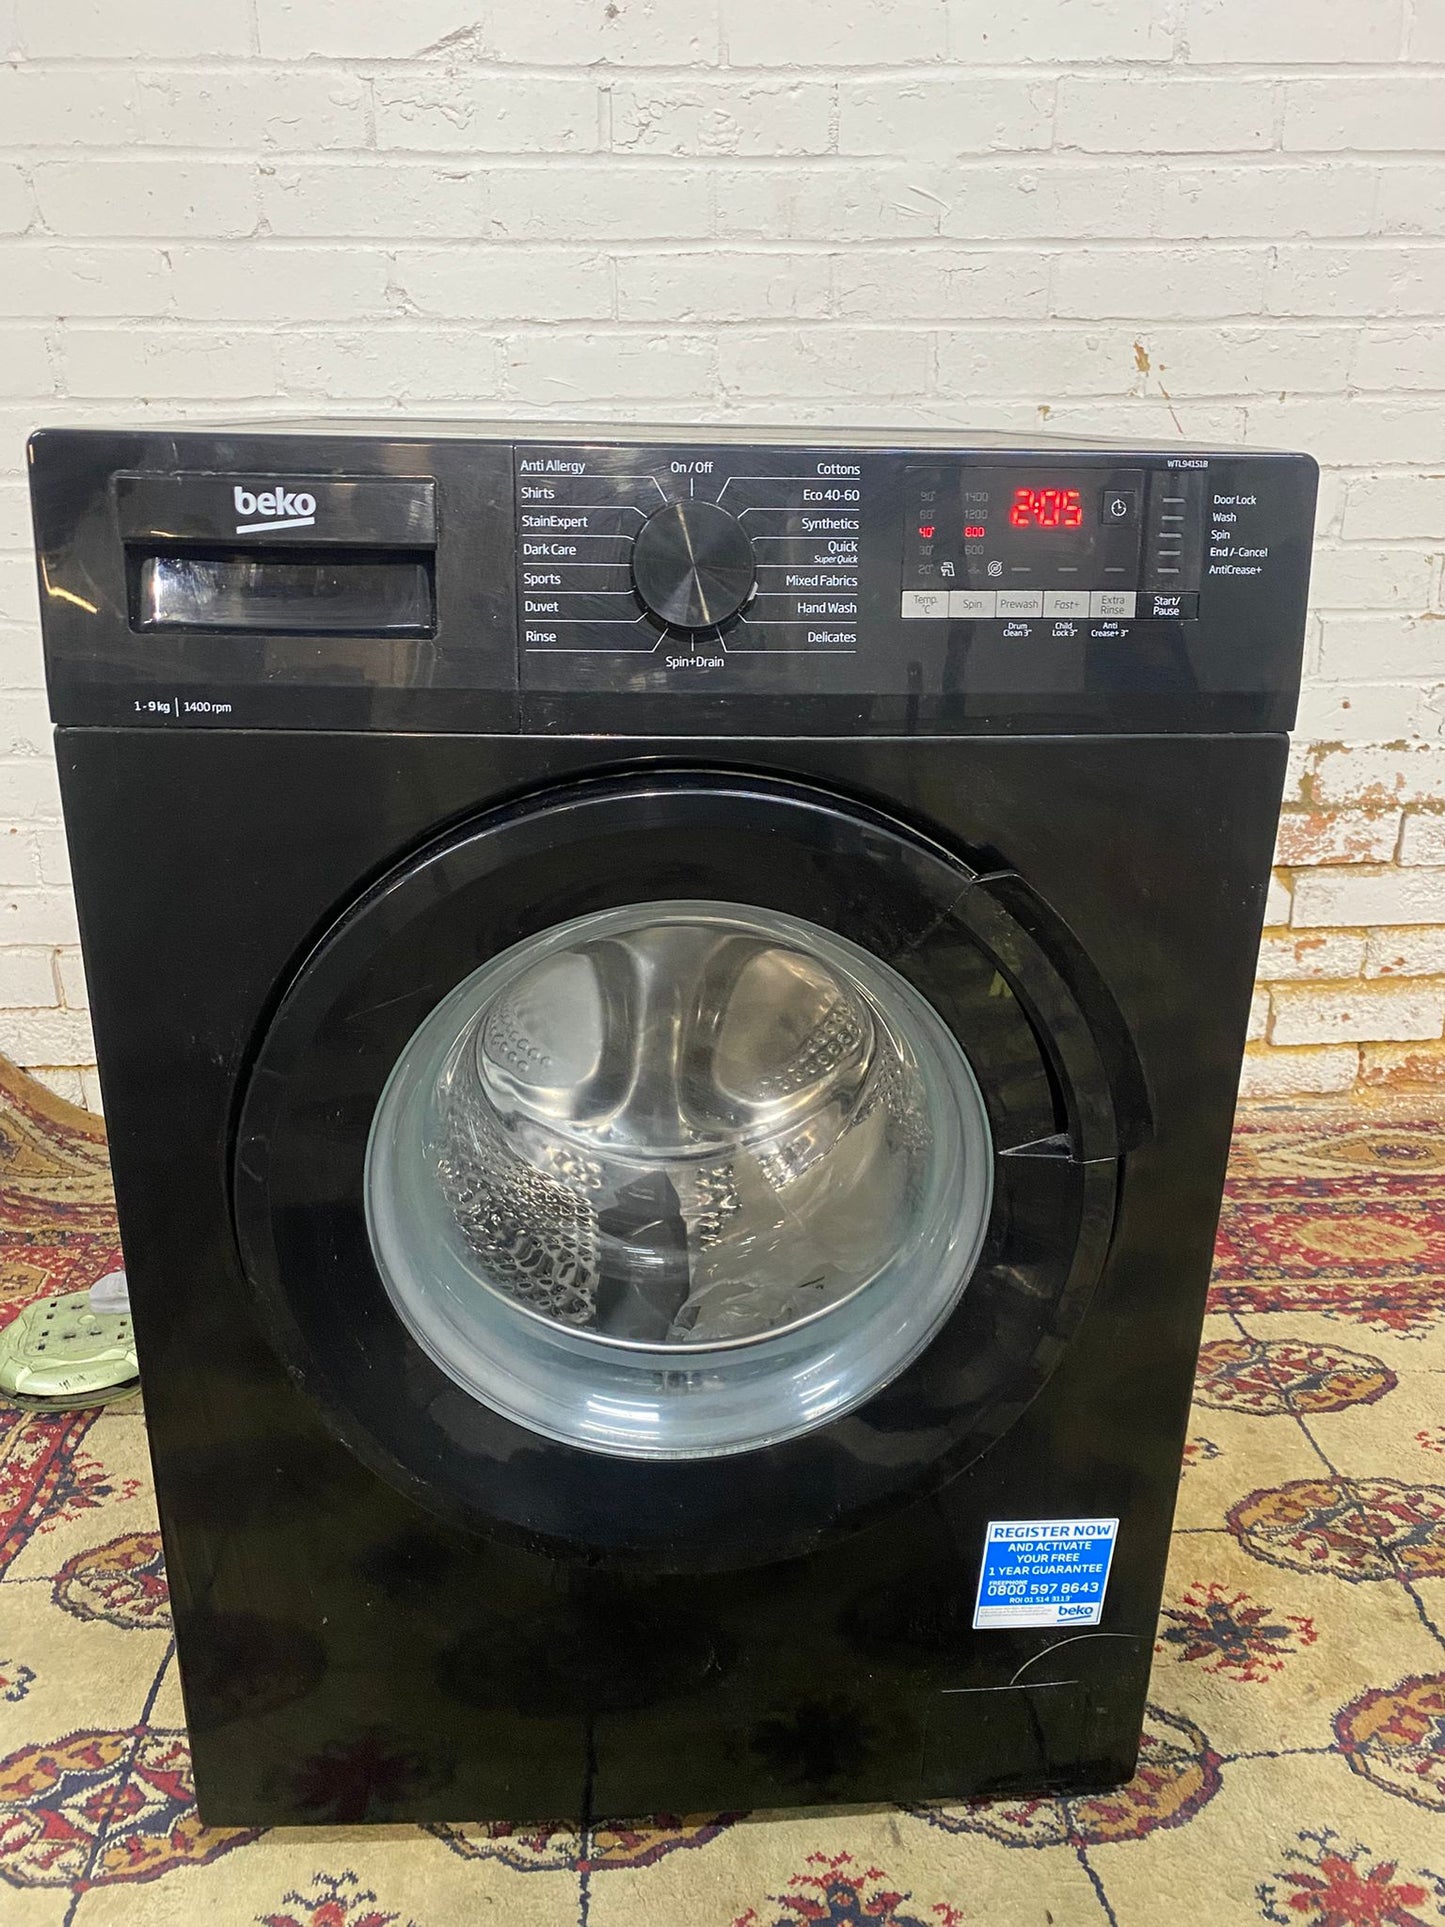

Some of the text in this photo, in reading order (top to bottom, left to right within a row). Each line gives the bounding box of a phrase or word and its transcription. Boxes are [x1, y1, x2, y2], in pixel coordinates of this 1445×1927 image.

[520, 460, 586, 475] Anti Allergy
[671, 461, 687, 473] On
[695, 461, 714, 474] Off
[817, 463, 861, 475] Cottons
[521, 487, 555, 499] Shirts
[803, 489, 860, 501] Eco 40-60
[234, 486, 317, 516] beko
[1213, 495, 1257, 505] Door Lock
[1011, 489, 1083, 526] 2:05
[521, 515, 589, 530] StainExpert
[1212, 513, 1238, 523] Wash
[801, 518, 860, 532] Synthetics
[1211, 530, 1231, 541] Spin
[523, 544, 577, 556] Dark Care
[828, 541, 859, 555] Quick
[1210, 547, 1229, 557] End
[814, 555, 859, 565] Super Quick
[523, 572, 562, 587] Sports
[786, 575, 858, 587] Mixed Fabrics
[963, 599, 983, 610] Spin
[1000, 599, 1039, 610] Prewash
[1054, 599, 1080, 610] Fast+
[1101, 595, 1126, 605] Extra
[1153, 596, 1181, 606] Start/
[524, 600, 560, 613] Duvet
[797, 602, 858, 614] Hand Wash
[1100, 605, 1125, 616] Rinse
[1152, 606, 1181, 617] Pause
[1008, 622, 1029, 630] Drum
[1055, 622, 1073, 630] Child
[1102, 622, 1118, 630] Anti
[525, 630, 558, 642] Rinse
[807, 631, 858, 643] Delicates
[1003, 629, 1024, 637] Clean
[1052, 629, 1069, 637] Lock
[665, 655, 725, 670] Spin+Drain
[994, 1525, 1111, 1538] REGISTER NOW
[1007, 1541, 1092, 1552] AND ACTIVATE
[1016, 1553, 1080, 1563] YOUR FREE
[988, 1564, 1103, 1576] 1 YEAR GUARANTEE
[987, 1582, 1099, 1596] 0800 597 8643
[1058, 1605, 1094, 1616] beko
